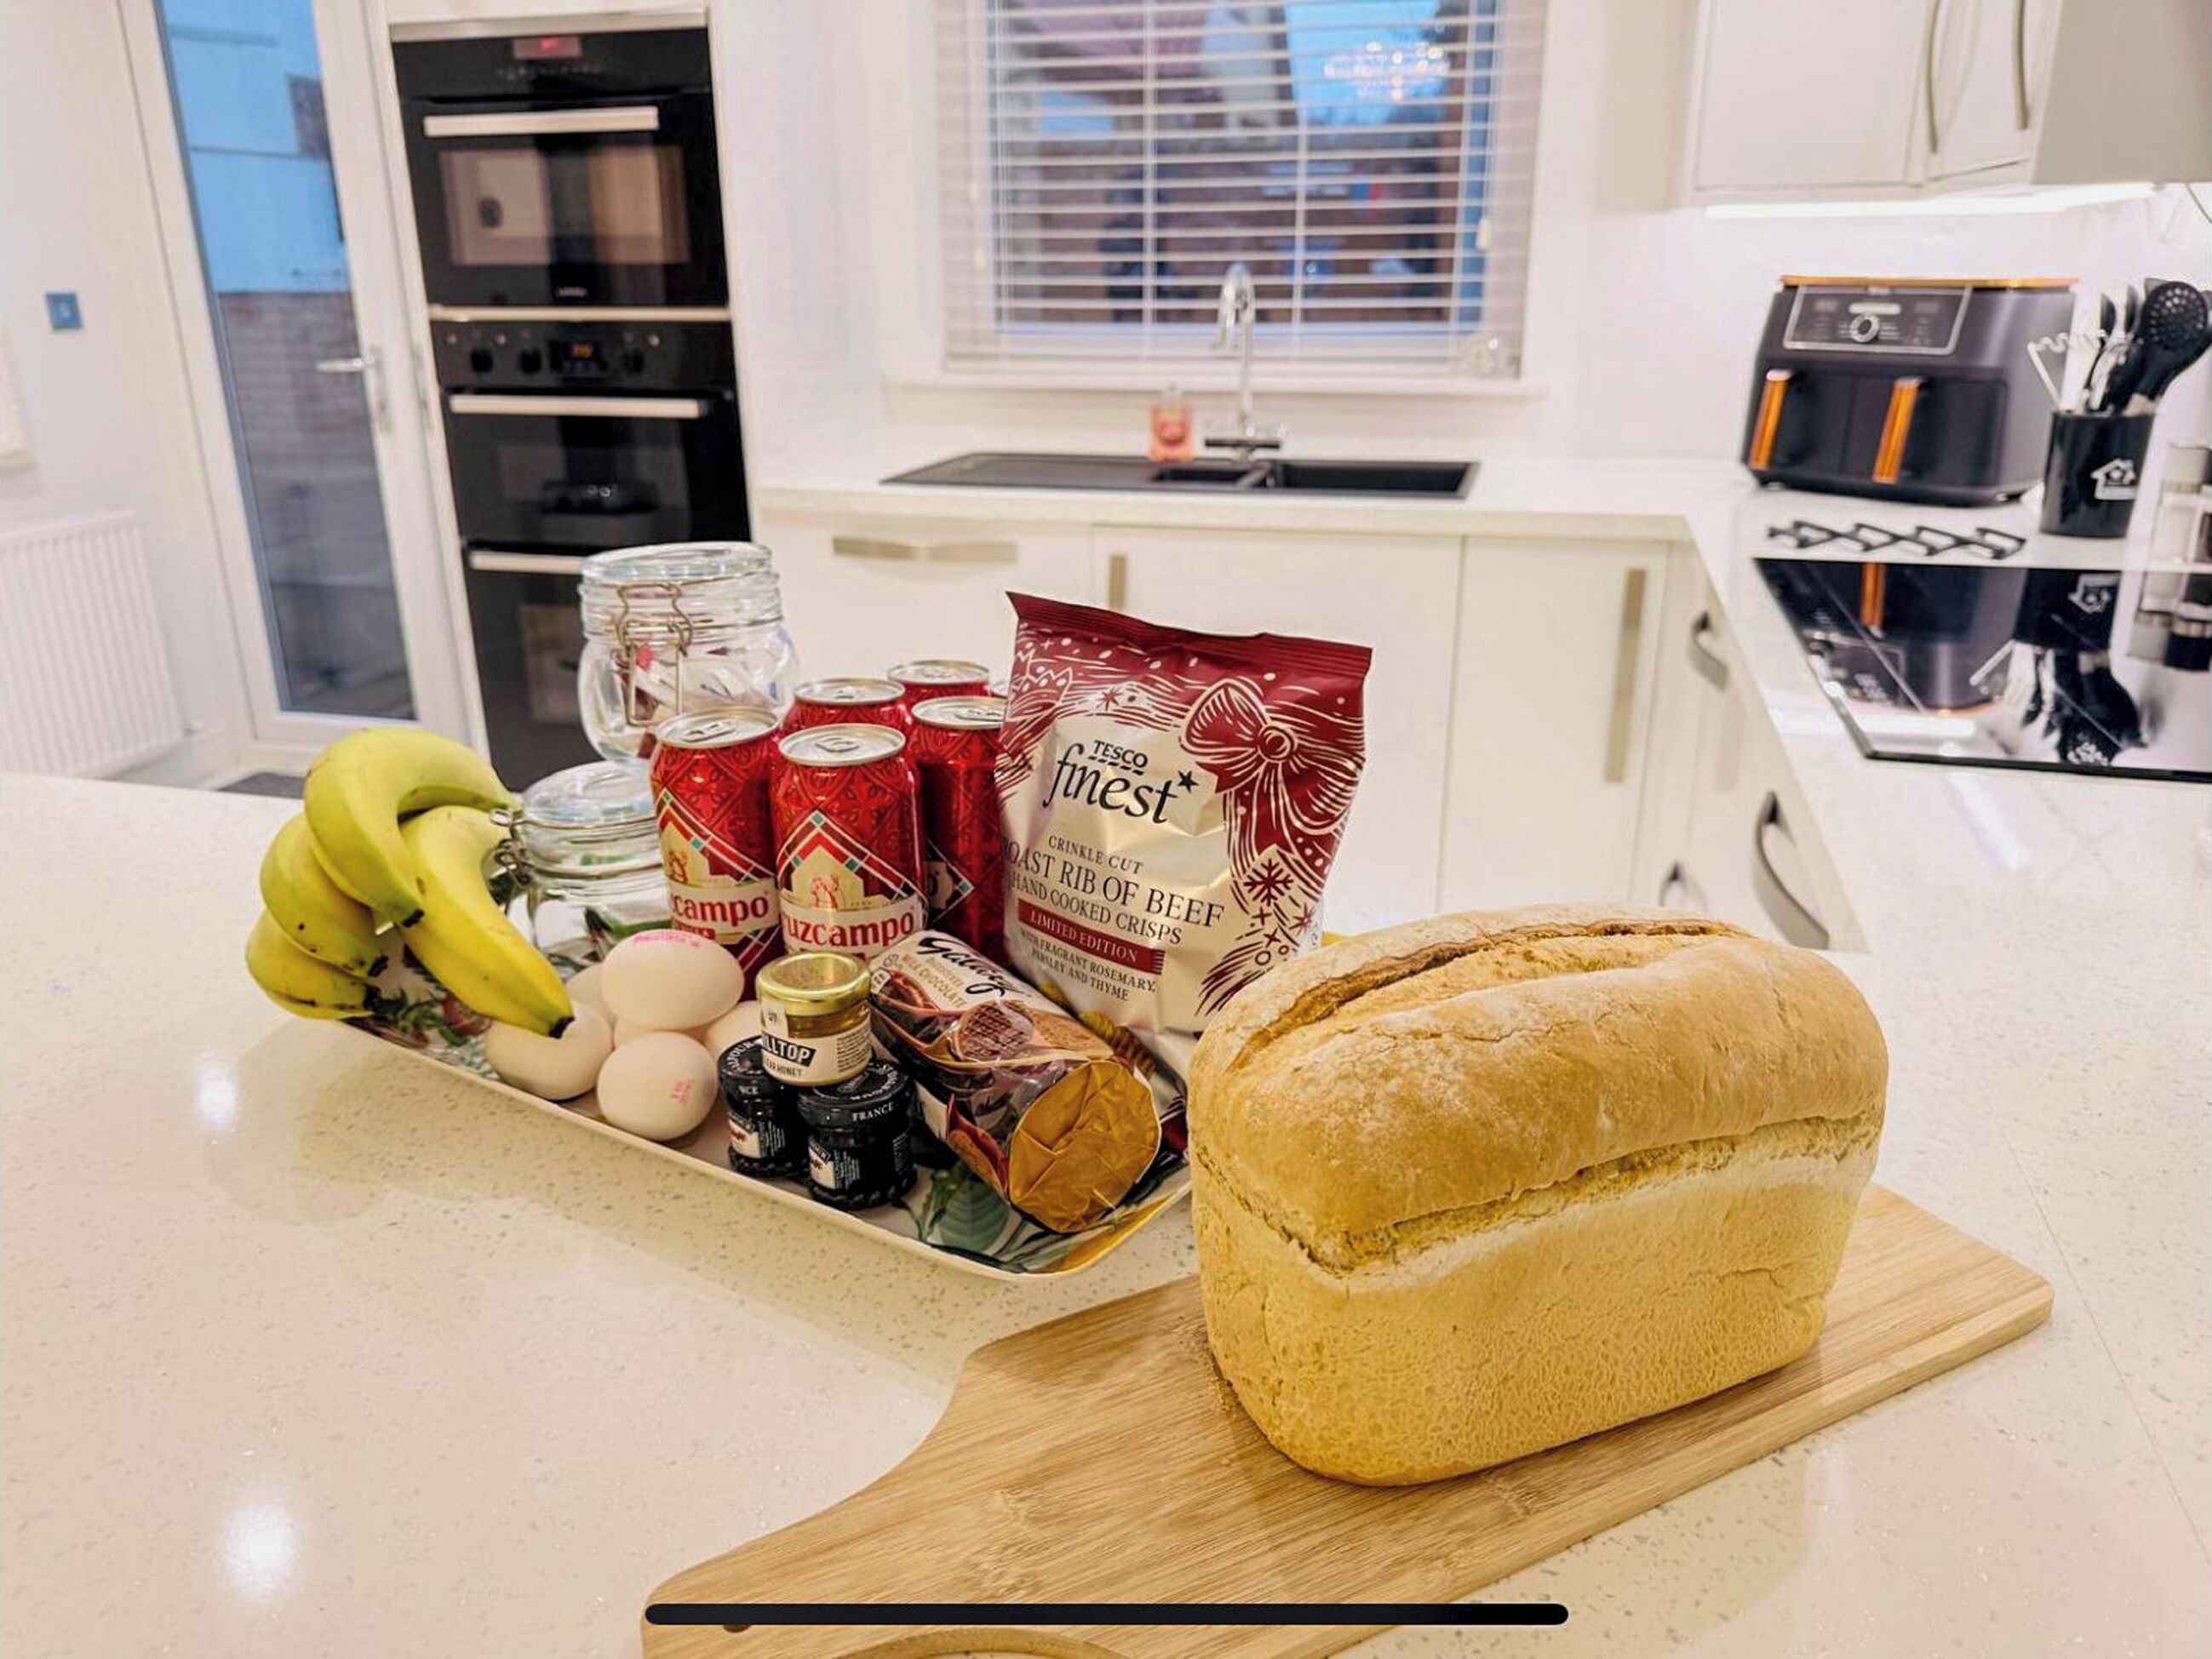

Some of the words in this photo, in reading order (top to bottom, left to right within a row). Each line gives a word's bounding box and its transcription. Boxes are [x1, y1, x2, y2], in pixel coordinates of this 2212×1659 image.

[1093, 740, 1149, 769] TESCO
[1042, 742, 1178, 825] finest
[1048, 835, 1103, 865] CRINKLE
[1109, 855, 1143, 874] CUT
[672, 894, 770, 928] campo
[1011, 871, 1048, 901] HAND
[1051, 888, 1111, 924] COOKED
[1115, 912, 1183, 946] CRISPS
[1059, 859, 1096, 895] RIB
[1103, 876, 1139, 907] OF
[1145, 888, 1225, 928] BEEF
[1030, 910, 1078, 941] LIMITED
[1080, 928, 1138, 963] EDITION
[1040, 938, 1087, 970] FRAGRANT
[1069, 966, 1089, 983] AND
[1090, 977, 1130, 1002] THYME
[852, 1101, 894, 1121] FRANCE
